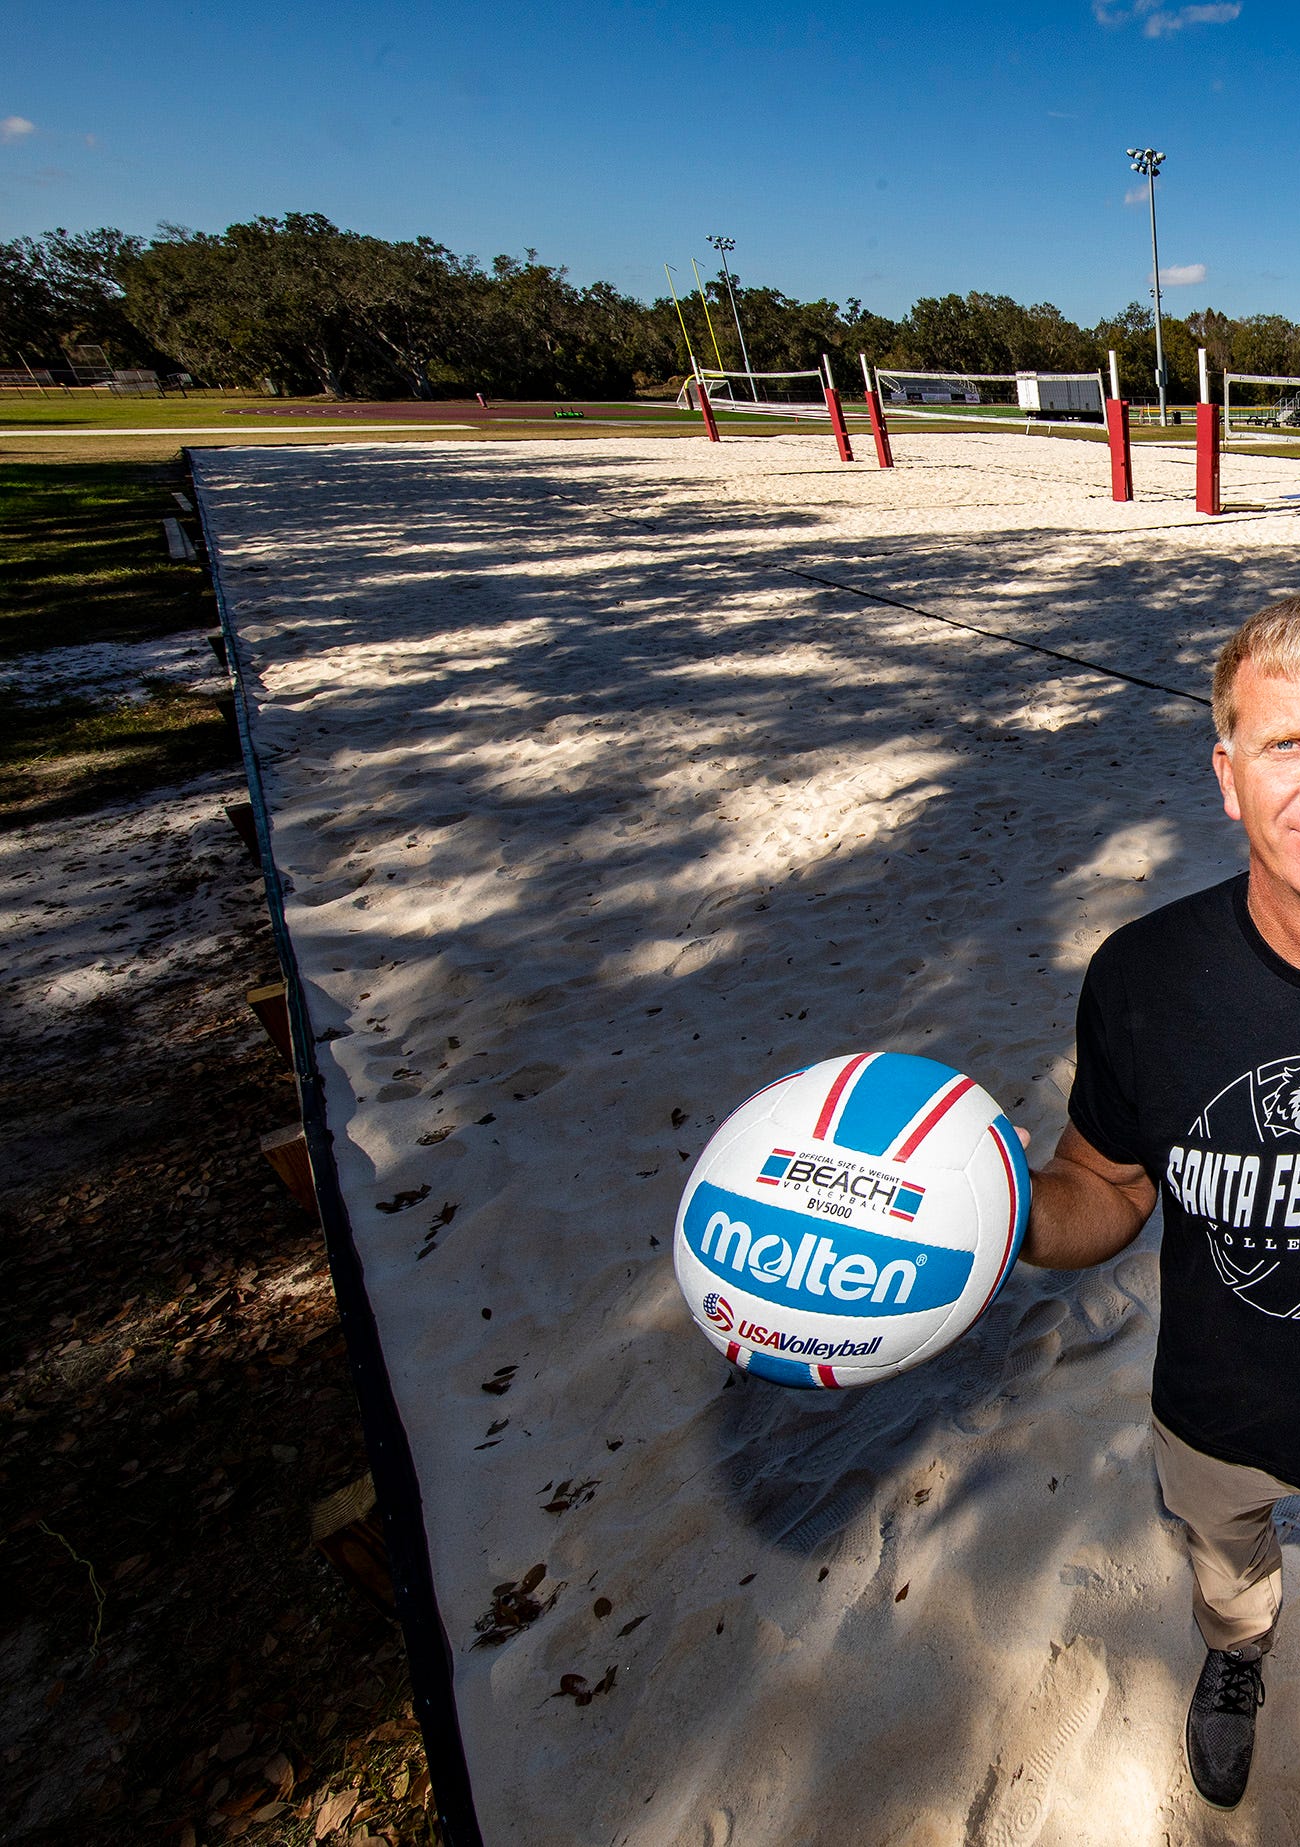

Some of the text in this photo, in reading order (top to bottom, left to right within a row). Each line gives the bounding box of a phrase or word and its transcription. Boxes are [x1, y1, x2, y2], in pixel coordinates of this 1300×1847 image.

[786, 1159, 898, 1206] BEACH
[799, 1152, 834, 1165] OFFICIAL
[837, 1160, 857, 1171] SIZE
[869, 1168, 900, 1184] WEIGHT
[1166, 1145, 1261, 1228] SANTA
[783, 1181, 888, 1215] VOLLEYBALL
[807, 1198, 853, 1220] BV5000
[700, 1210, 918, 1304] molten
